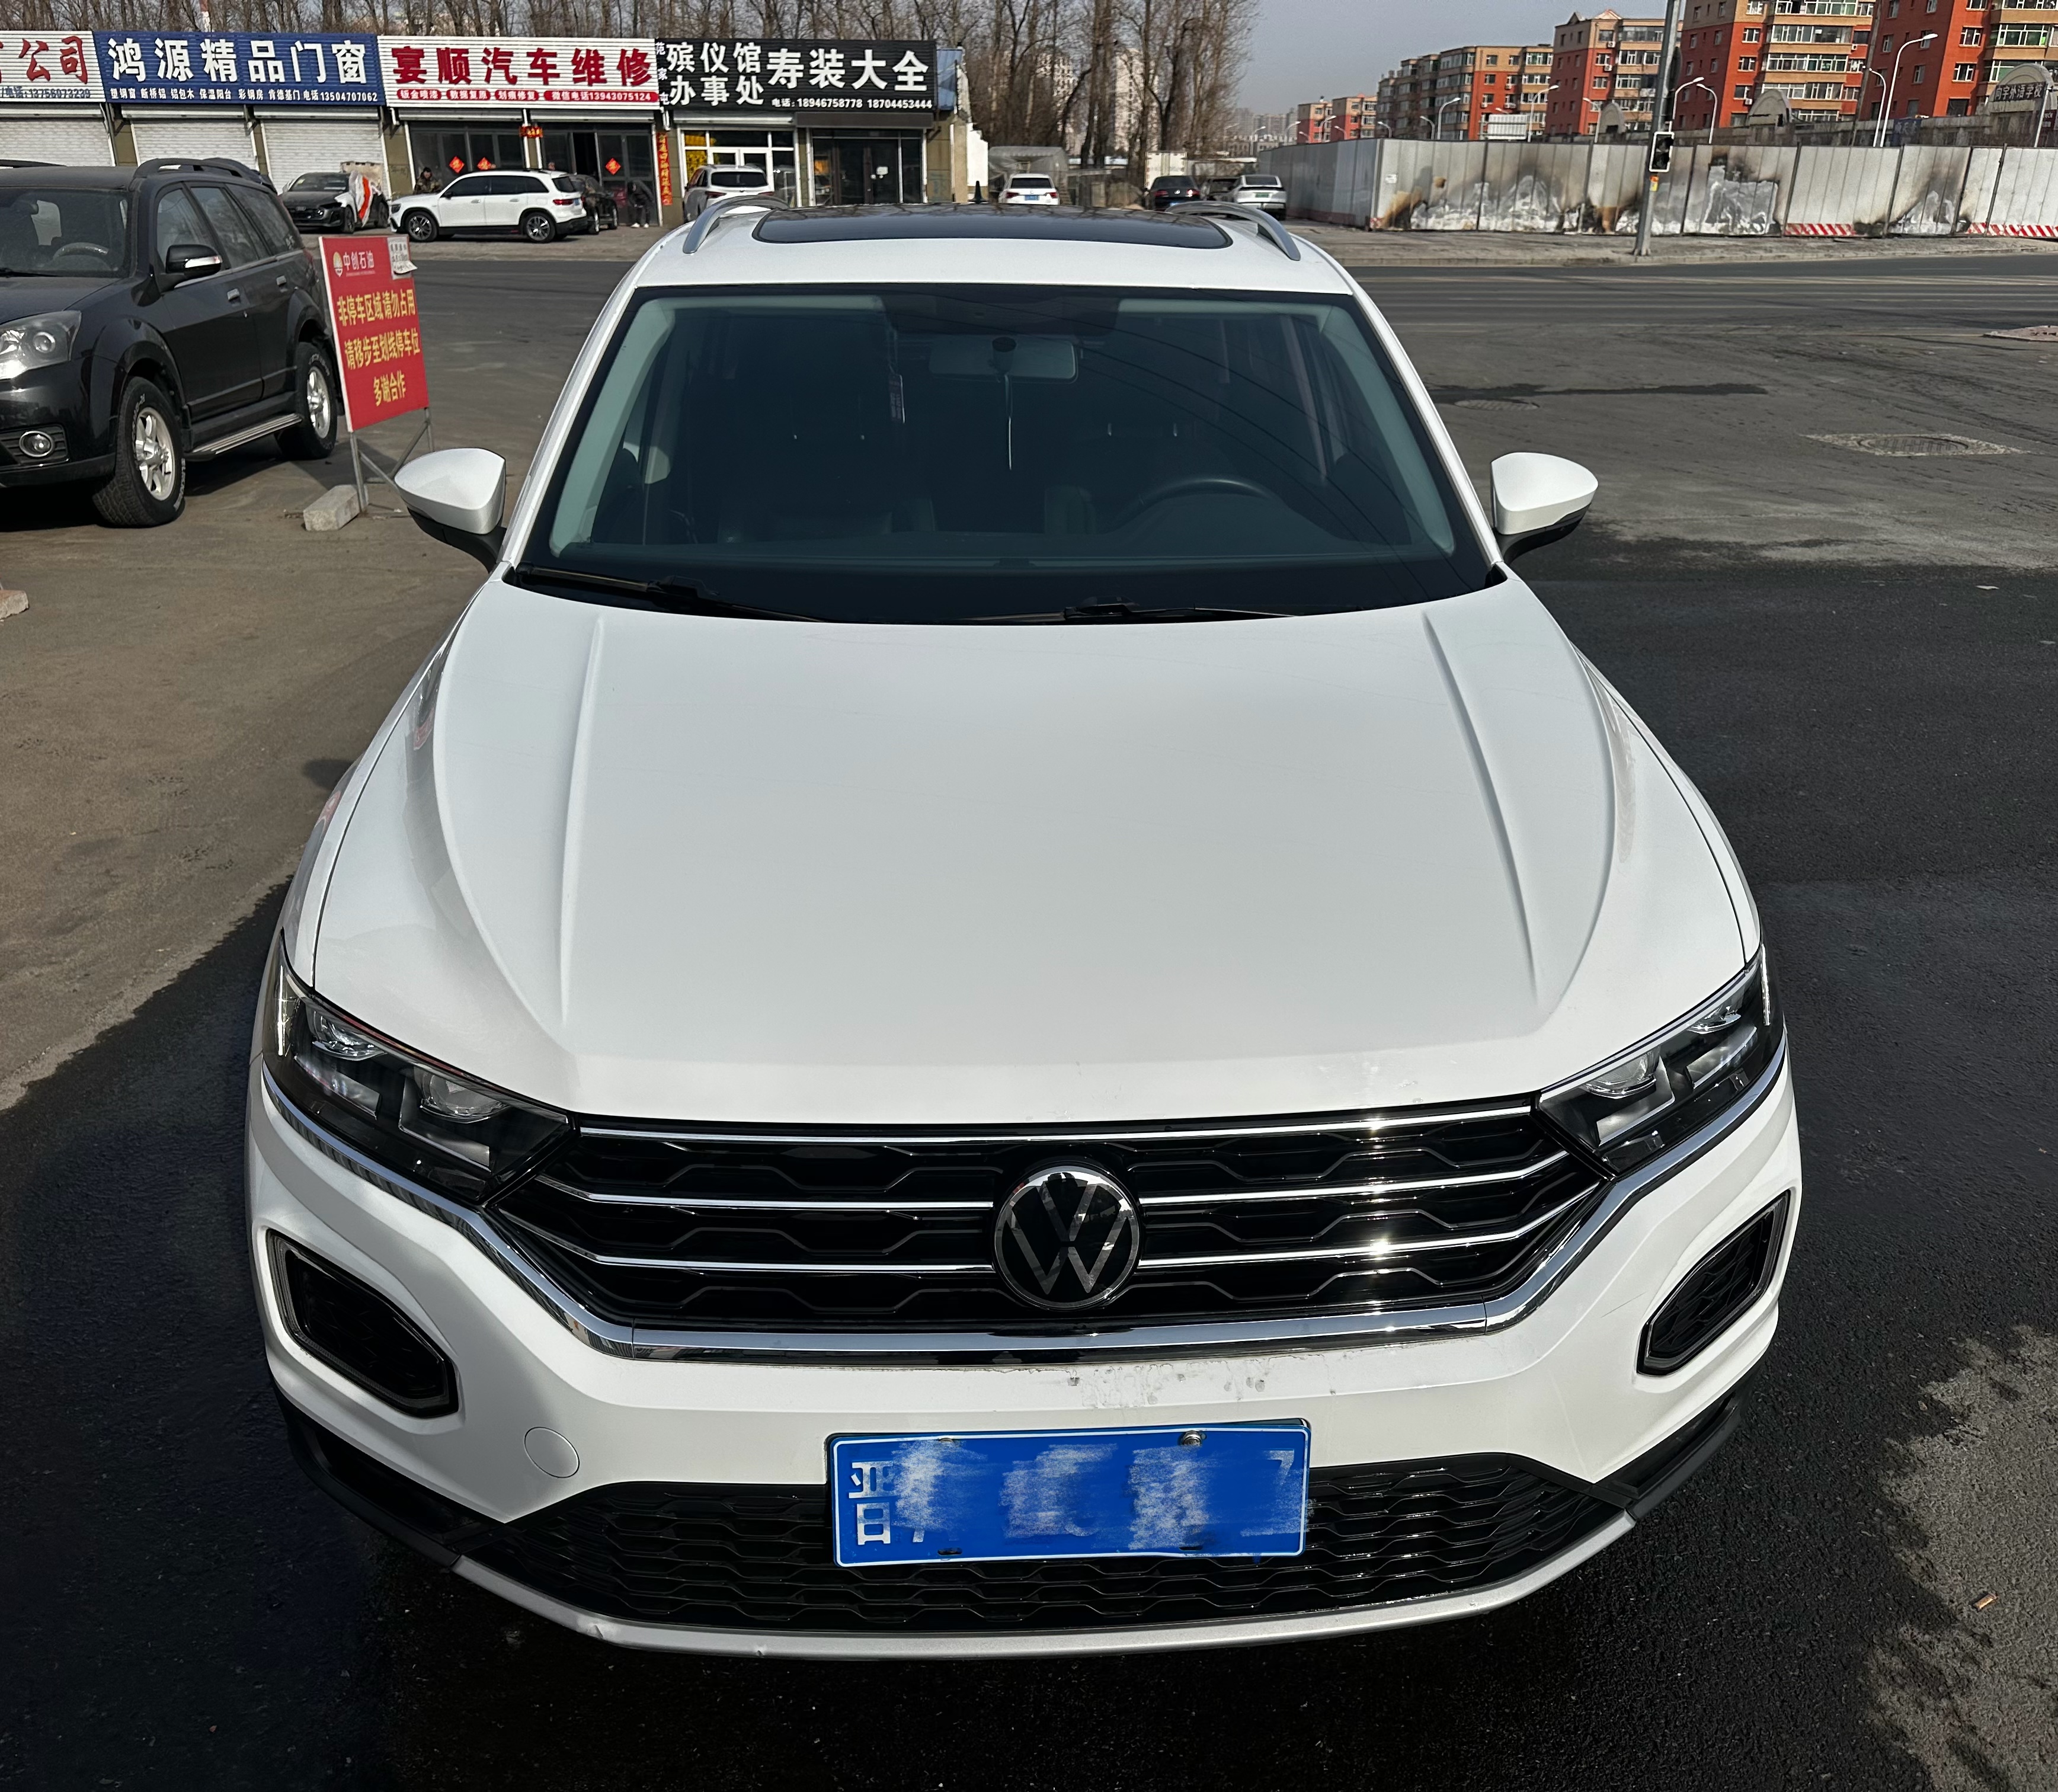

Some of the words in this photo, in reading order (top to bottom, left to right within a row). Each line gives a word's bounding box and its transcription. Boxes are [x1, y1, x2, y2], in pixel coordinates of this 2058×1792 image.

[0, 36, 88, 84] 公司
[108, 38, 367, 84] 鸿源精品门窗
[391, 46, 652, 86] 宴顺汽车维修
[666, 41, 761, 73] 殡仪馆
[766, 48, 929, 91] 寿装大全
[171, 88, 195, 100] 铝包木
[199, 88, 232, 100] 保温阳台
[238, 88, 263, 100] 彩钢房
[268, 89, 300, 101] 肯德基门
[669, 75, 764, 107] 办事处
[867, 99, 933, 109] 18704453444
[343, 250, 375, 271] 中创石油
[337, 289, 415, 327] 非停车区域请勿占用
[344, 327, 420, 370] 请移步至划线停车位
